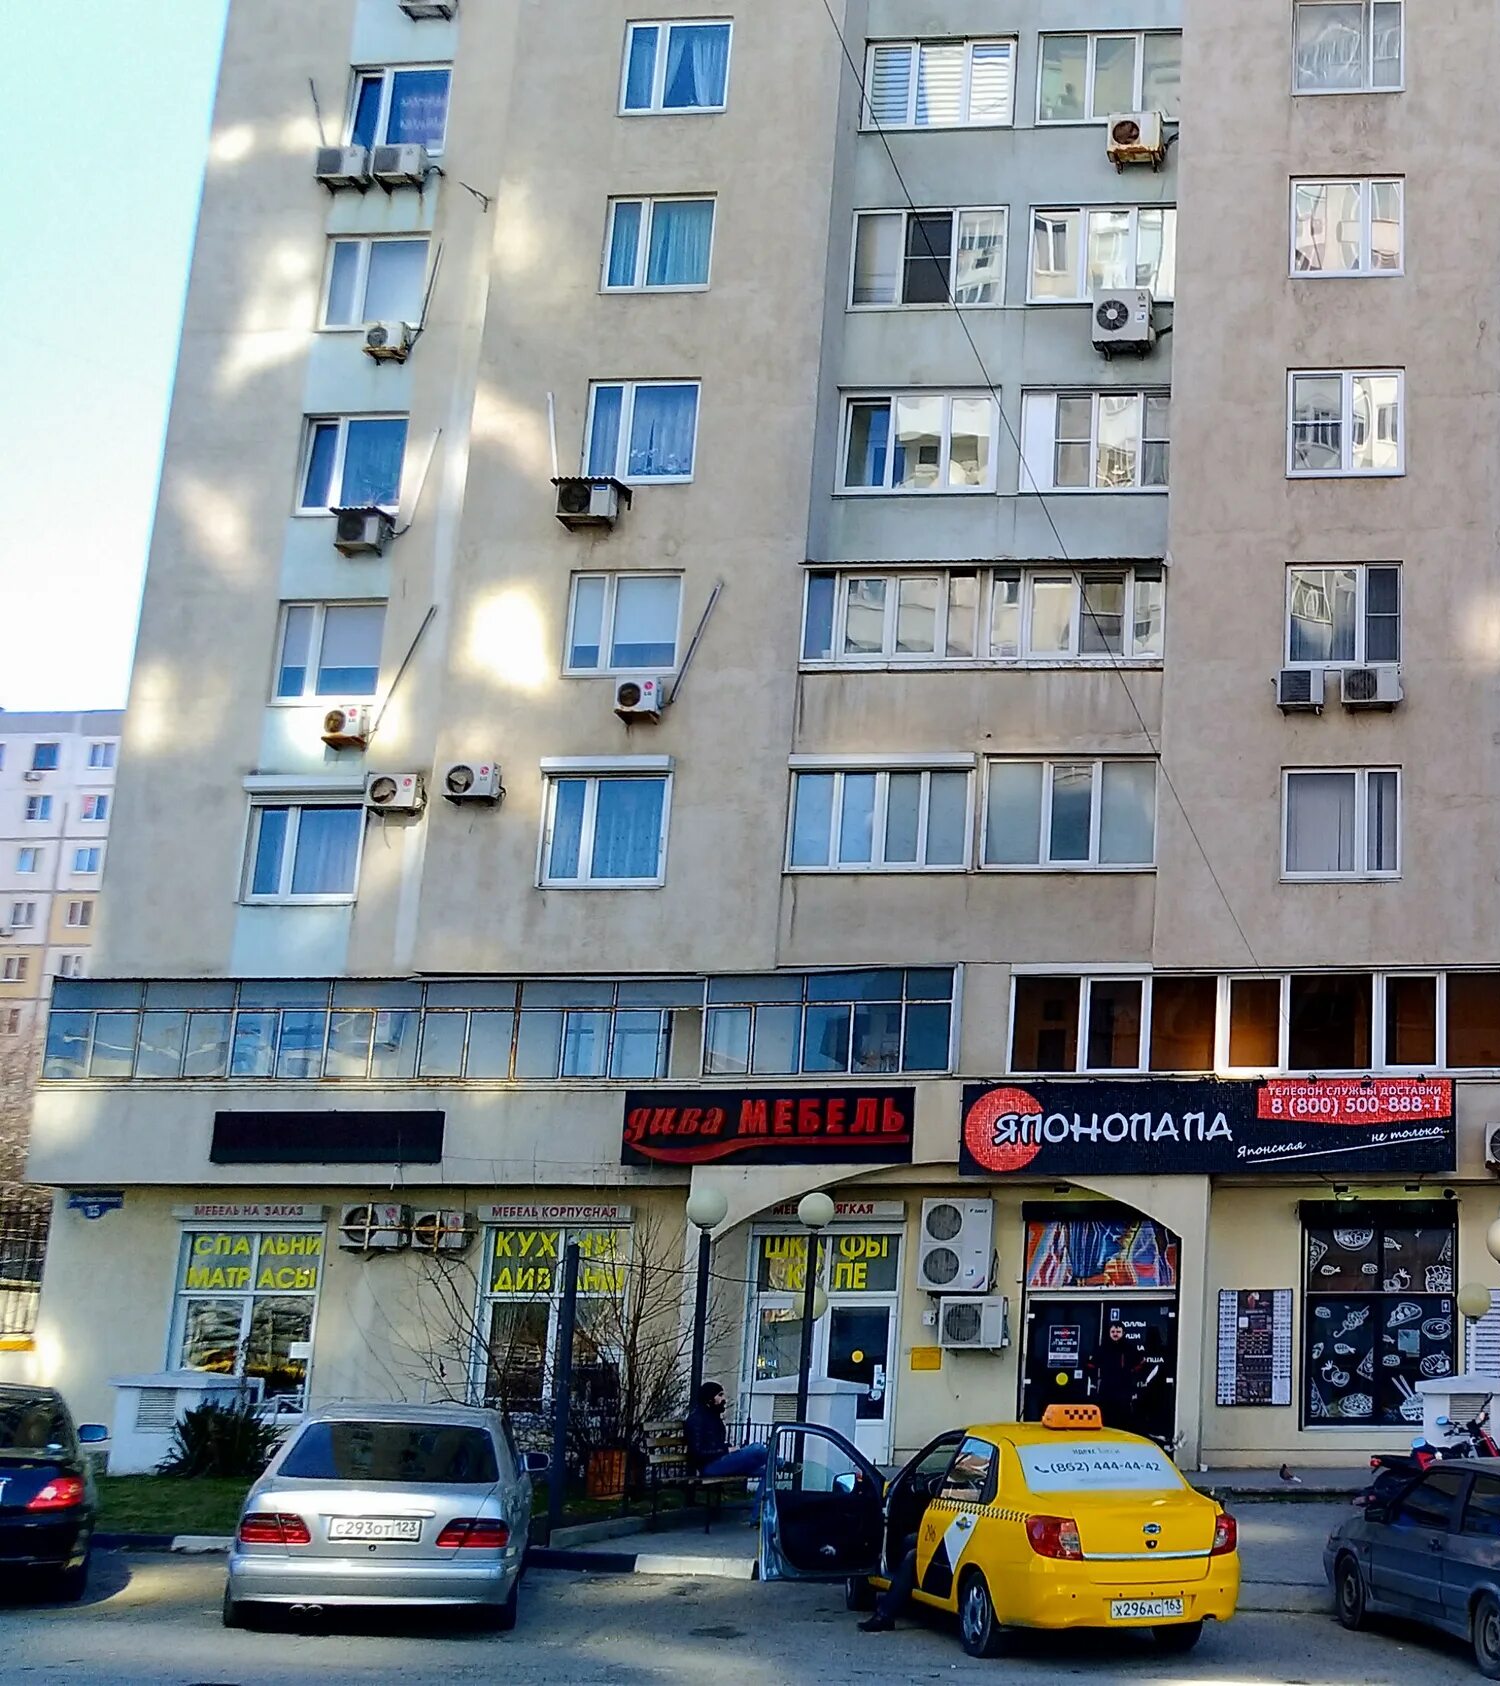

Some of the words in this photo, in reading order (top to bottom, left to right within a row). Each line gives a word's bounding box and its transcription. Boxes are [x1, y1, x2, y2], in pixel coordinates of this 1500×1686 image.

[1268, 1087, 1323, 1096] ТЕЛЕФОН
[1326, 1086, 1377, 1096] СЛУЖБЫ
[1380, 1086, 1442, 1096] ДОСТАВКИ
[1271, 1099, 1283, 1114] 8
[1289, 1097, 1339, 1117] (800)
[738, 1098, 906, 1135] МЕБЕЛЬ
[993, 1112, 1233, 1144] ЯПОНОПАПА
[1237, 1141, 1308, 1158] Японская
[1371, 1132, 1386, 1143] не
[194, 1206, 240, 1216] МЕБЕЛЬ
[243, 1206, 260, 1216] НА
[264, 1206, 304, 1216] ЗАКАЗ
[492, 1206, 539, 1217] МЕБЕЛЬ
[542, 1206, 617, 1217] КОРПУСНАЯ
[1050, 1463, 1089, 1474] (862)
[1093, 1462, 1160, 1472] 444-44-42
[336, 1522, 392, 1535] С293ОТ
[395, 1522, 417, 1532] 123
[1115, 1602, 1161, 1616] Х296АС
[1164, 1599, 1181, 1610] 163
